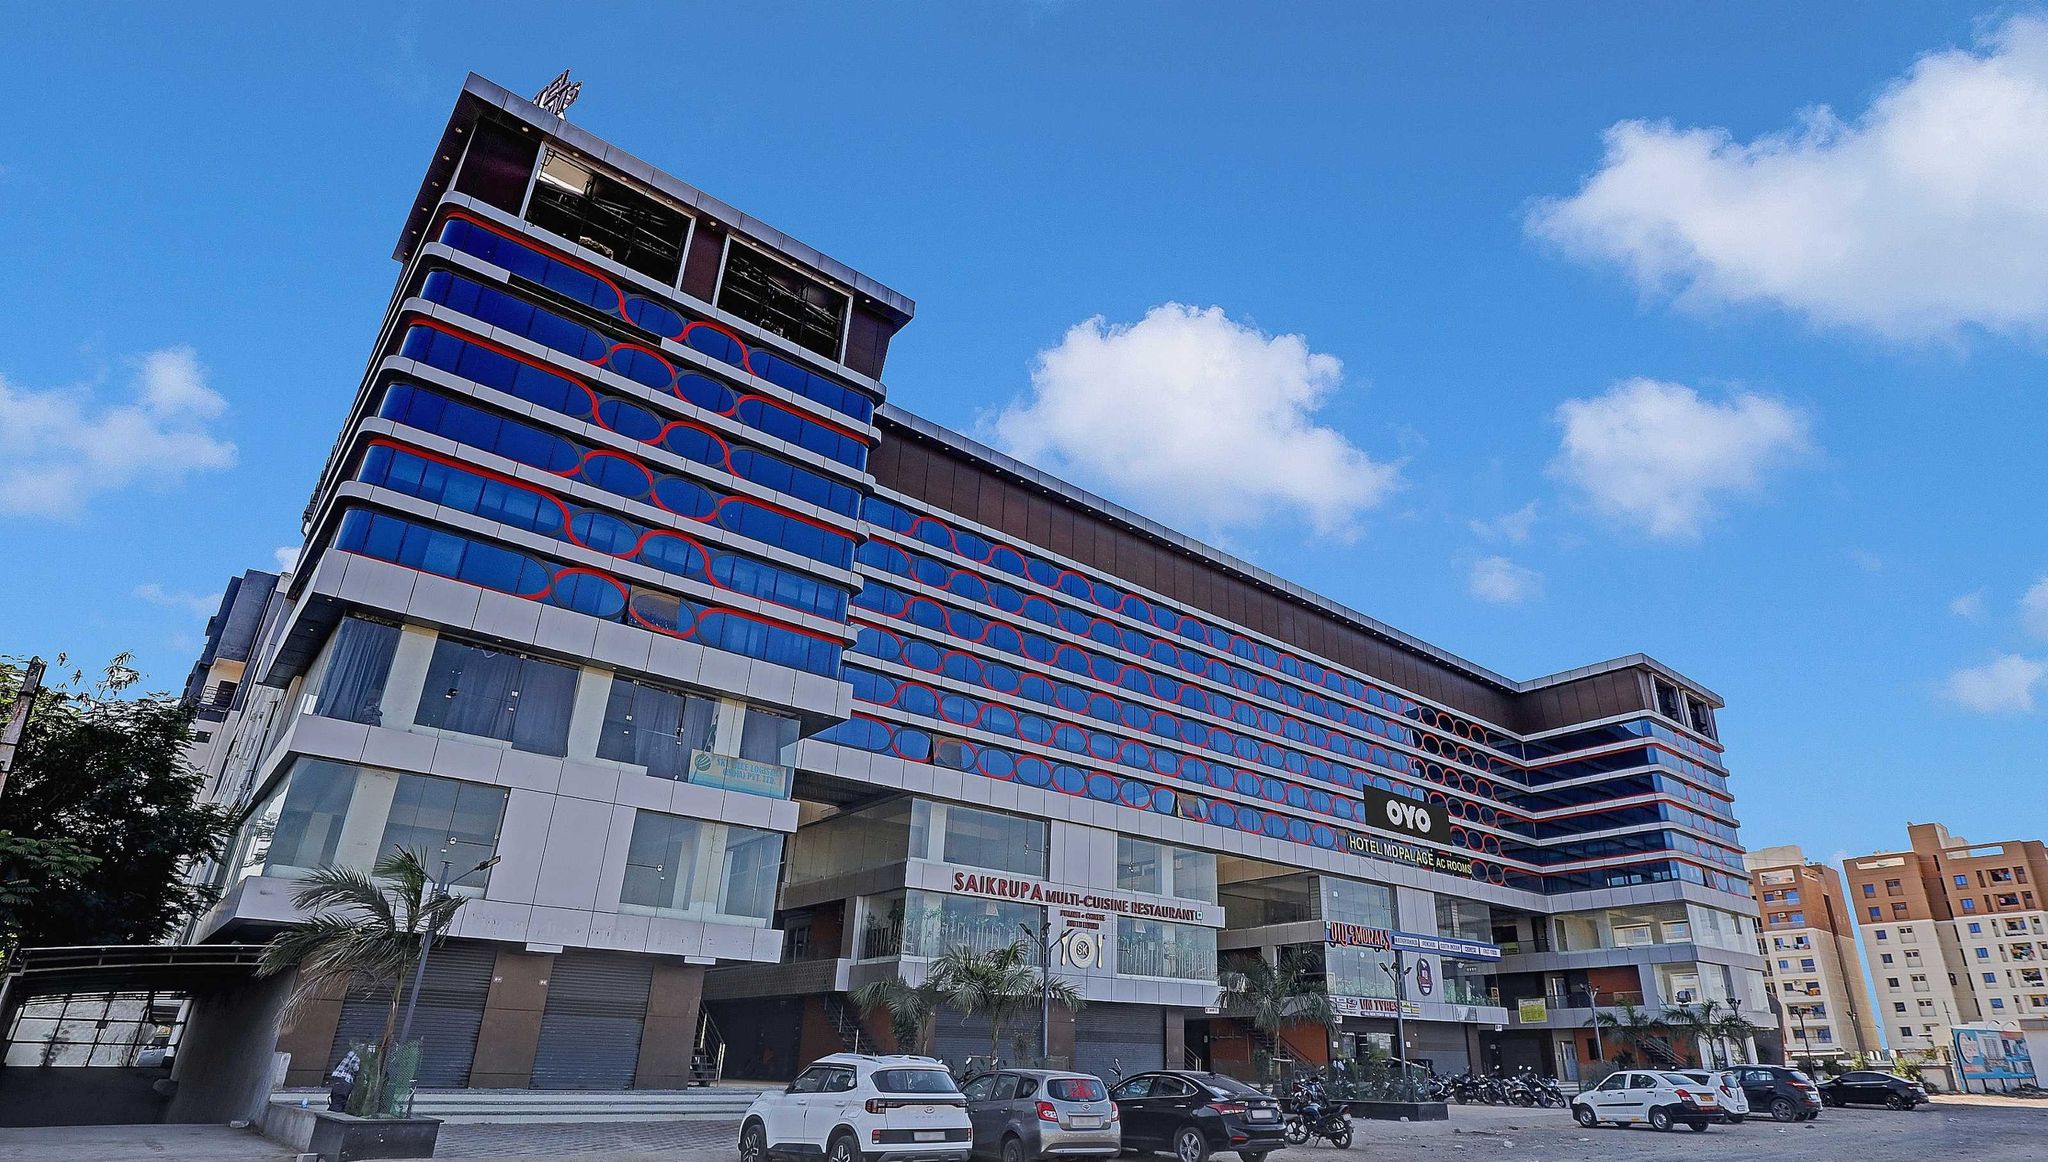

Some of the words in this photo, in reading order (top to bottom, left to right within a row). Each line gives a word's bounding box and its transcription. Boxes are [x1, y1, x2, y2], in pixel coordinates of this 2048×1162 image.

[1386, 799, 1432, 833] OYO
[1349, 834, 1383, 855] HOTEL
[1436, 859, 1447, 869] AC
[1446, 860, 1472, 874] ROOMS
[954, 872, 1043, 901] SAIKRUPA
[1045, 890, 1129, 912] MULTI-CUISINE
[1131, 901, 1196, 921] RESTAURANT
[1077, 944, 1088, 956] SK
